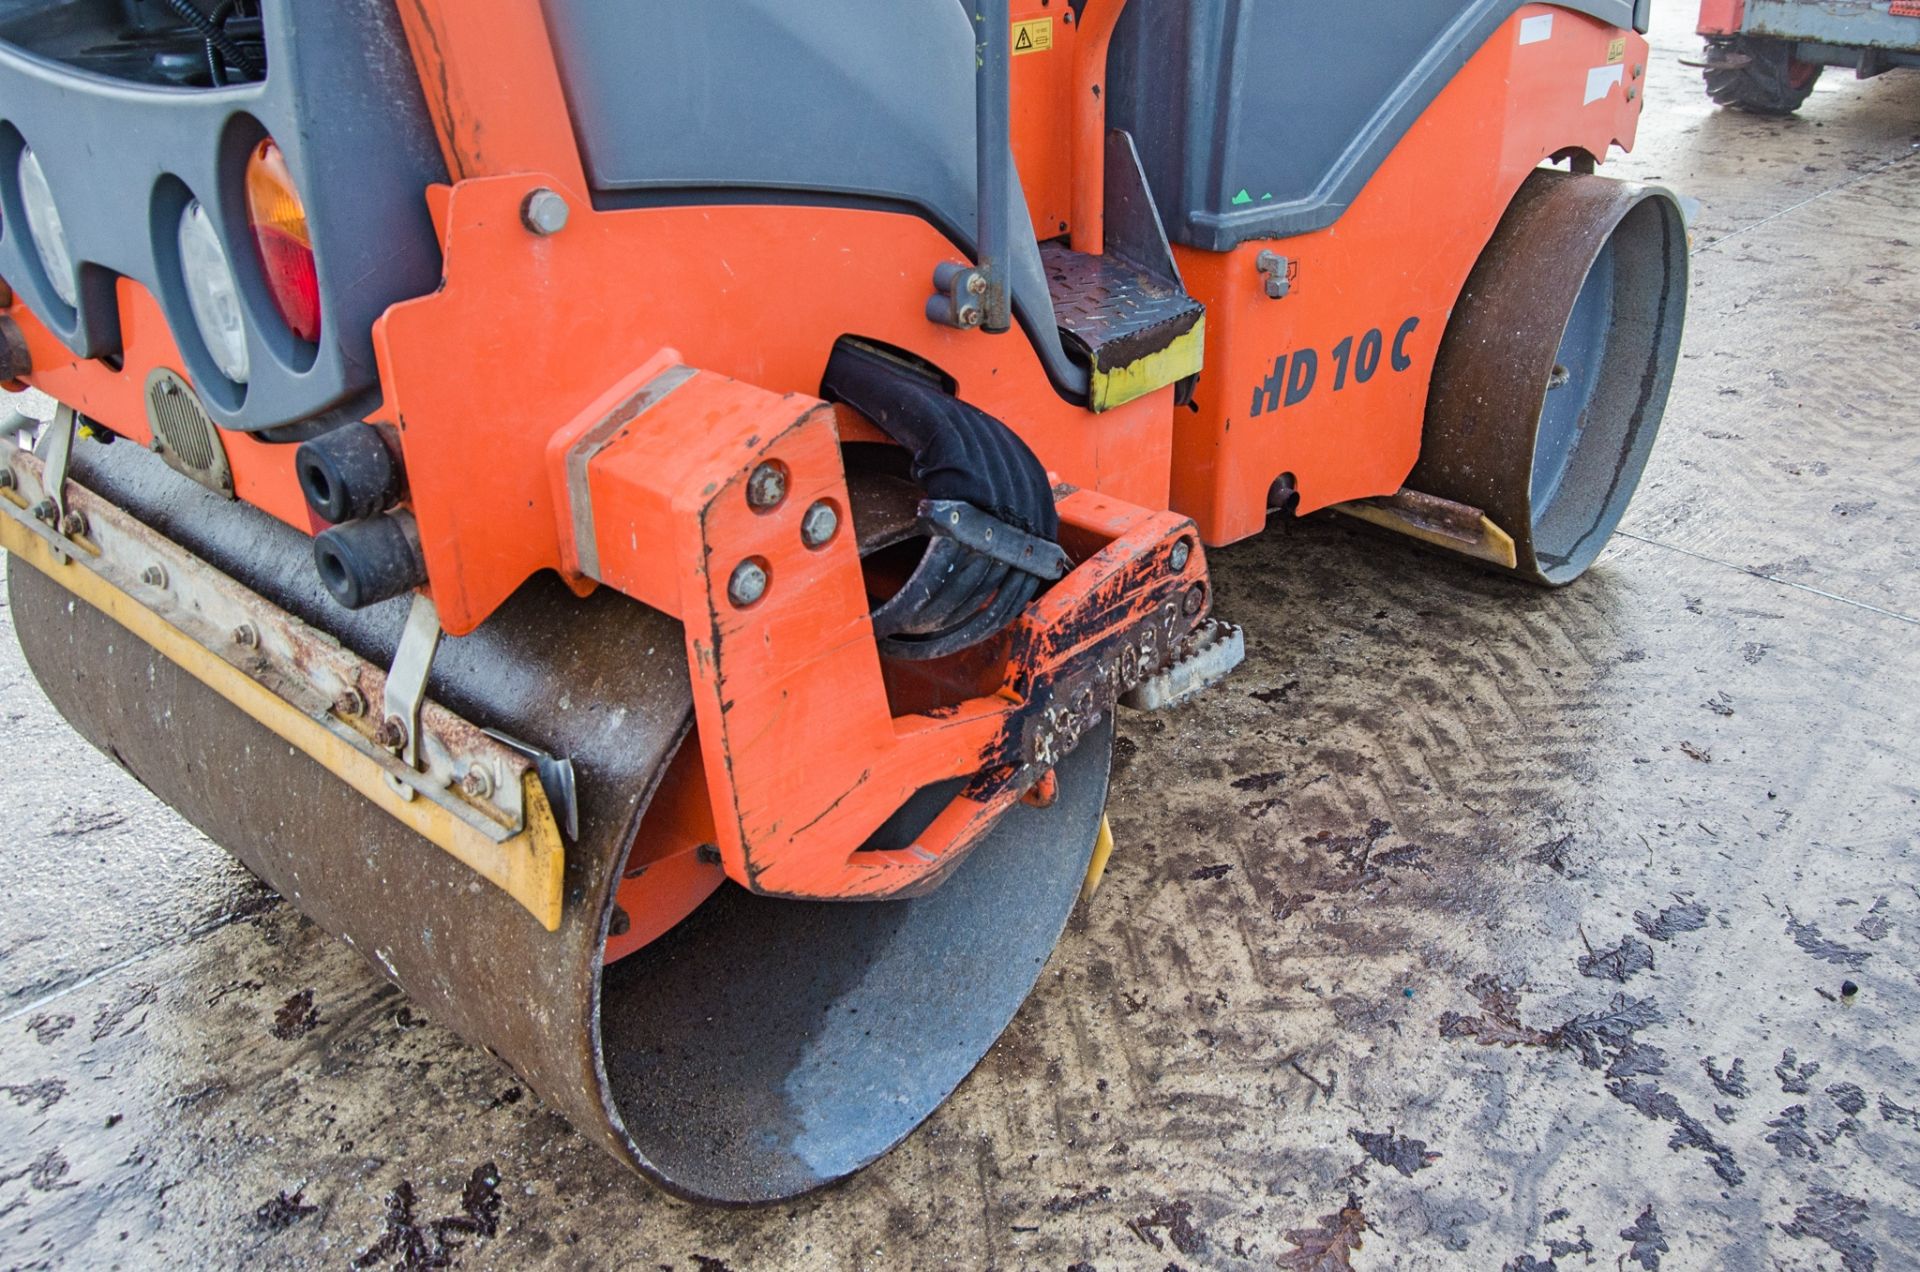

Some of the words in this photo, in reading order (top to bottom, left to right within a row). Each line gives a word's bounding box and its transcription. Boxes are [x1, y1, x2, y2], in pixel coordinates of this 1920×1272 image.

[1250, 348, 1318, 417] HD
[1332, 328, 1382, 391] 10
[1391, 316, 1420, 372] C
